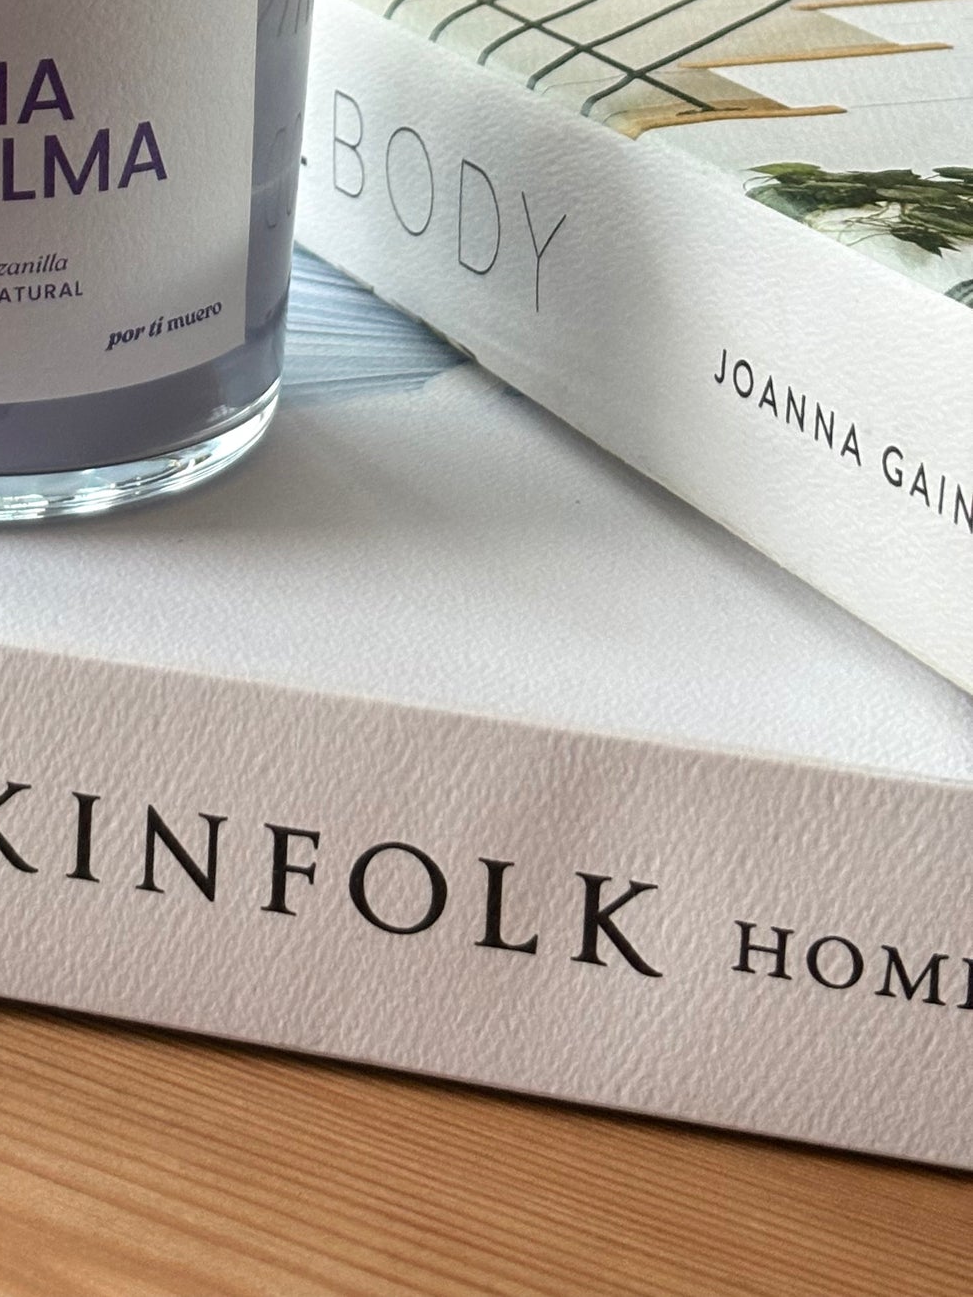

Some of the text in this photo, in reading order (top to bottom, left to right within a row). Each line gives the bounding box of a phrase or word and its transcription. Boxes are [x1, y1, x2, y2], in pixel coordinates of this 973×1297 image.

[105, 325, 146, 352] por
[166, 301, 223, 333] muero
[714, 348, 862, 467] JOANNA
